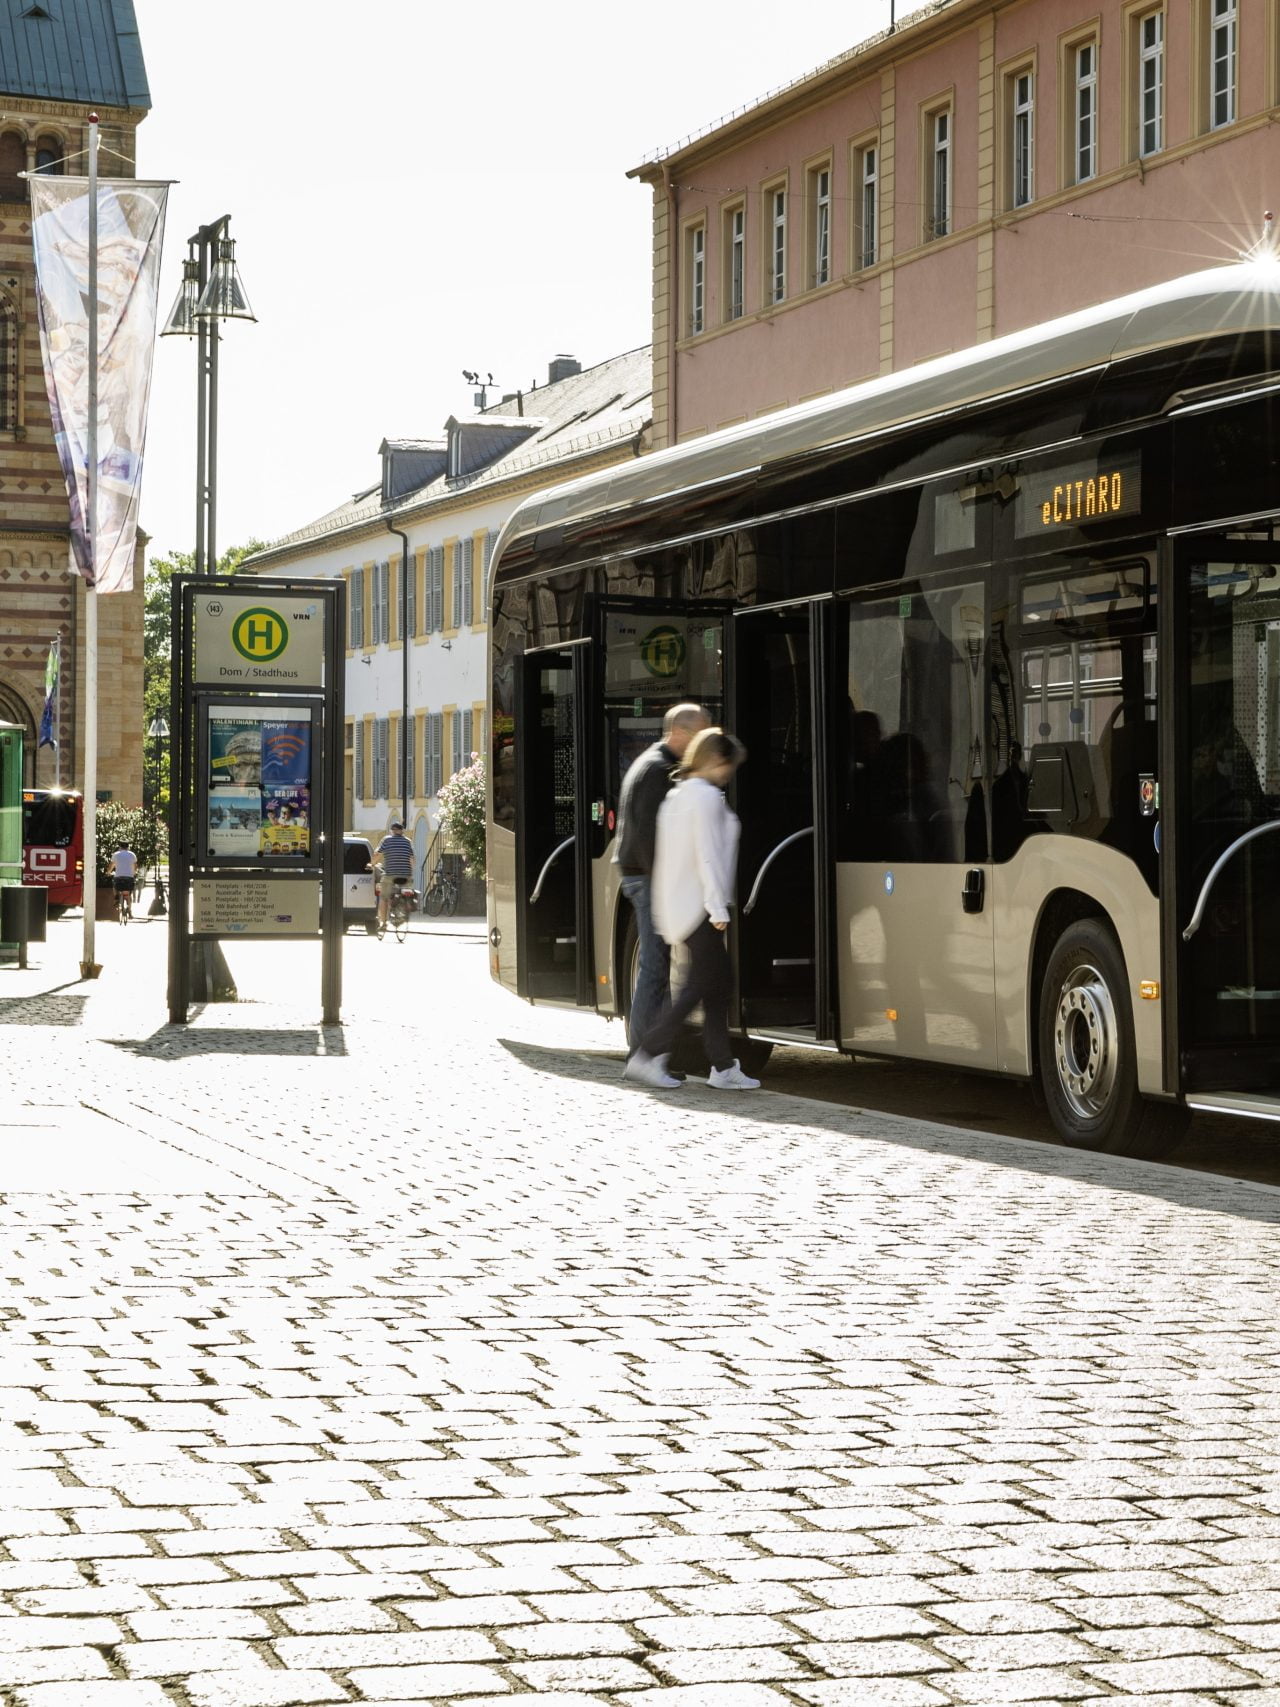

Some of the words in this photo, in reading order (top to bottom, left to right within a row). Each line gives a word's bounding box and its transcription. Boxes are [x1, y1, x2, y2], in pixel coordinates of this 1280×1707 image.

[1042, 472, 1121, 525] eCITARO
[210, 605, 220, 613] 143
[248, 620, 273, 650] H
[220, 667, 242, 676] Dom
[252, 668, 298, 678] Stadthaus
[286, 790, 298, 798] LIFE
